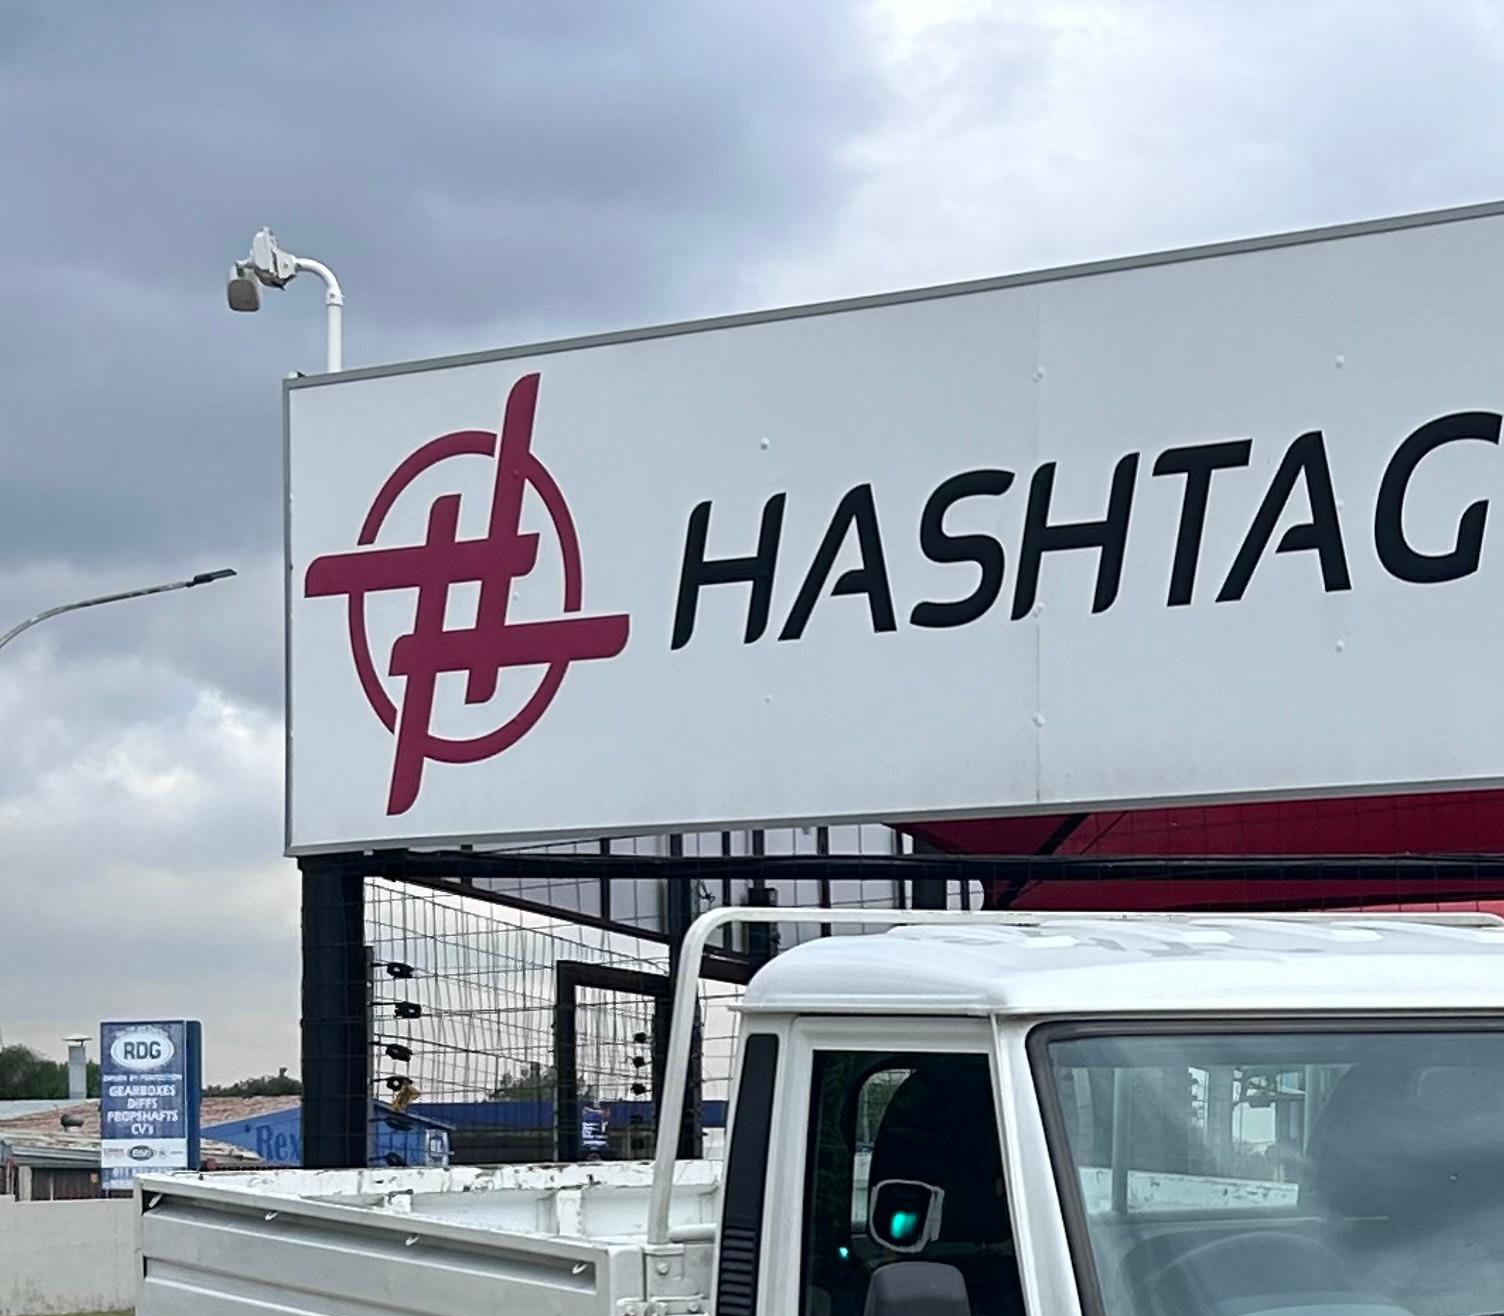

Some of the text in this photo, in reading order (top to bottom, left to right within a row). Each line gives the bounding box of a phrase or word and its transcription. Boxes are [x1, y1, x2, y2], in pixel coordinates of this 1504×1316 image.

[670, 411, 1504, 651] HASHTAG
[123, 1041, 162, 1060] RDG
[109, 1084, 176, 1097] GEARBOXES
[127, 1098, 158, 1109] DIFFS
